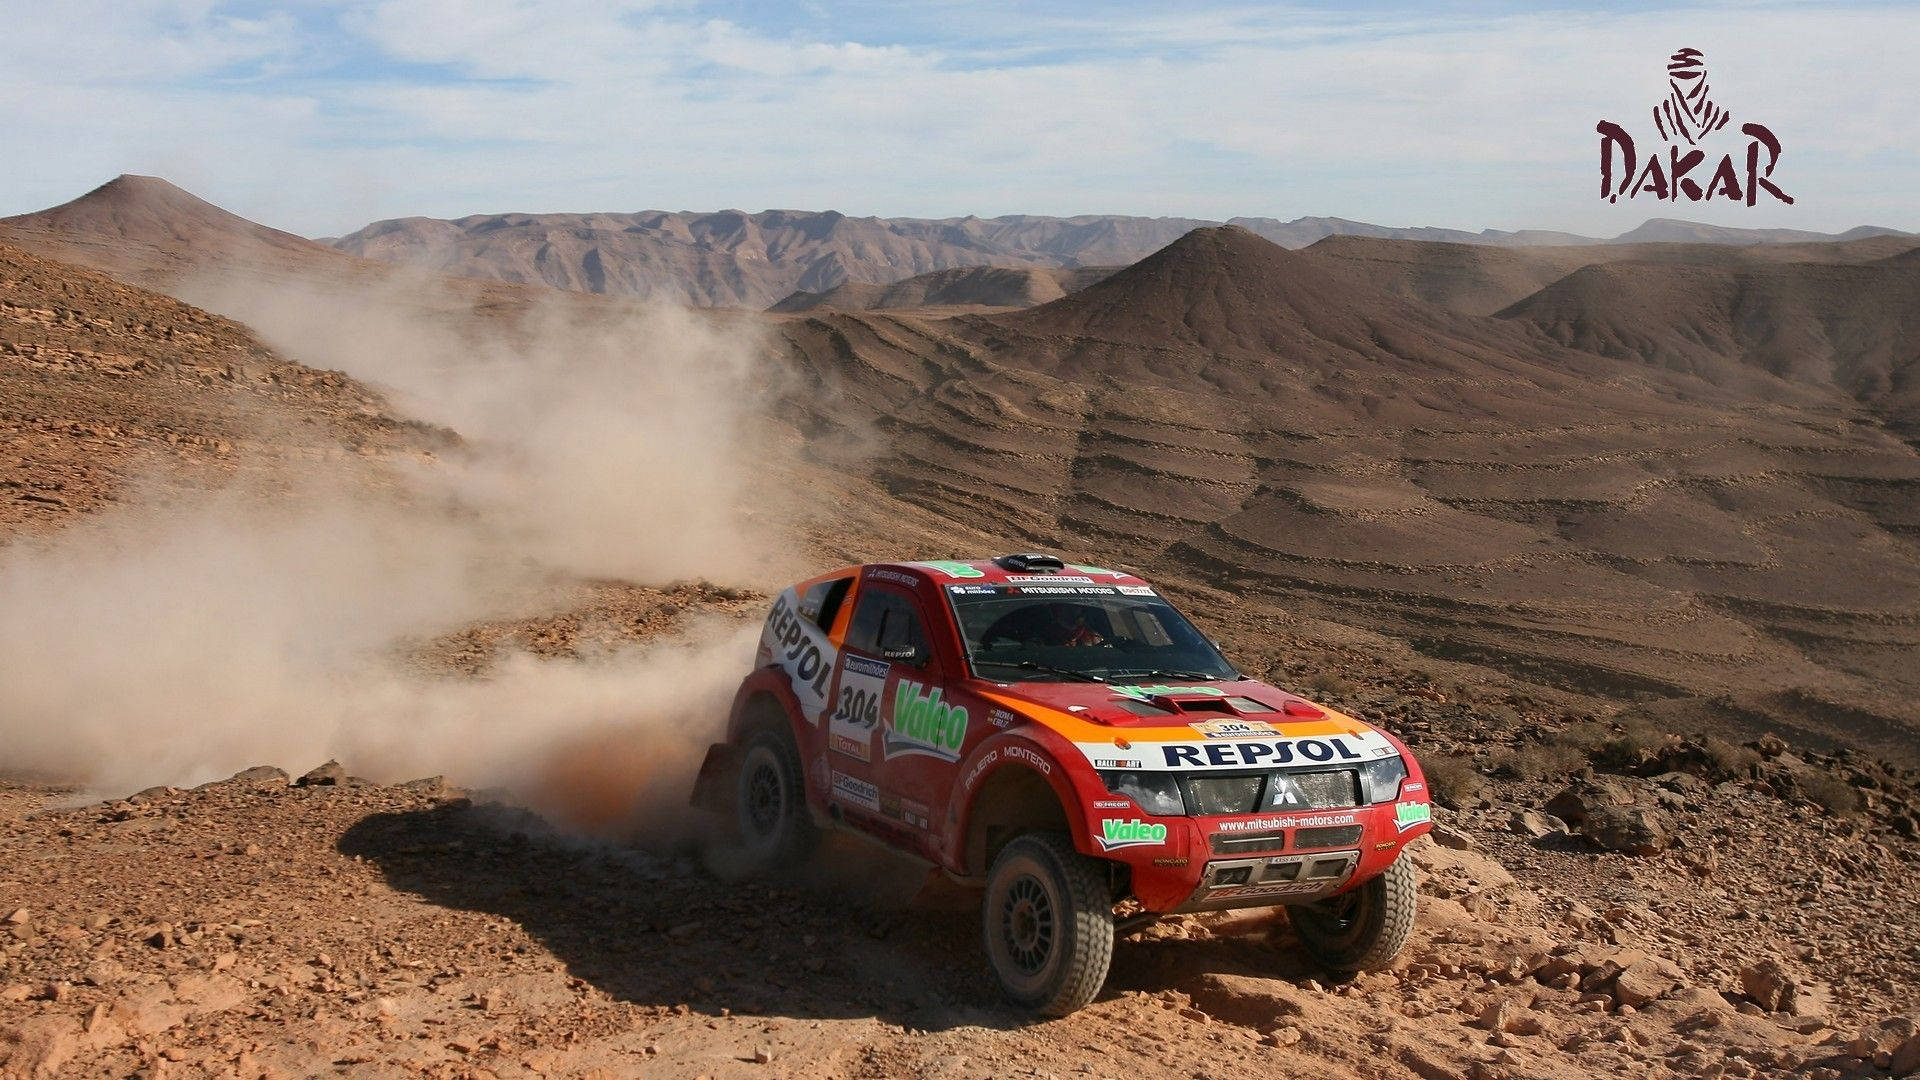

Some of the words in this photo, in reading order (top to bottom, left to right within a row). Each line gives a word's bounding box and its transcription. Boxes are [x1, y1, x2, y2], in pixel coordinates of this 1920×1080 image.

[1020, 586, 1077, 594] MITSUBISHI
[768, 594, 831, 699] REPSOL
[885, 648, 915, 657] REPSOL
[835, 685, 877, 729] 304
[894, 679, 968, 751] Valeo
[995, 709, 1014, 721] ROMA
[1220, 723, 1250, 732] 304
[837, 737, 861, 752] TOTAL
[1161, 739, 1362, 767] REPSOL
[1003, 746, 1051, 775] MONTERO
[1395, 801, 1431, 822] Valeo
[1102, 819, 1167, 841] Valeo
[1219, 815, 1354, 831] www.mitsubishi-motors.com
